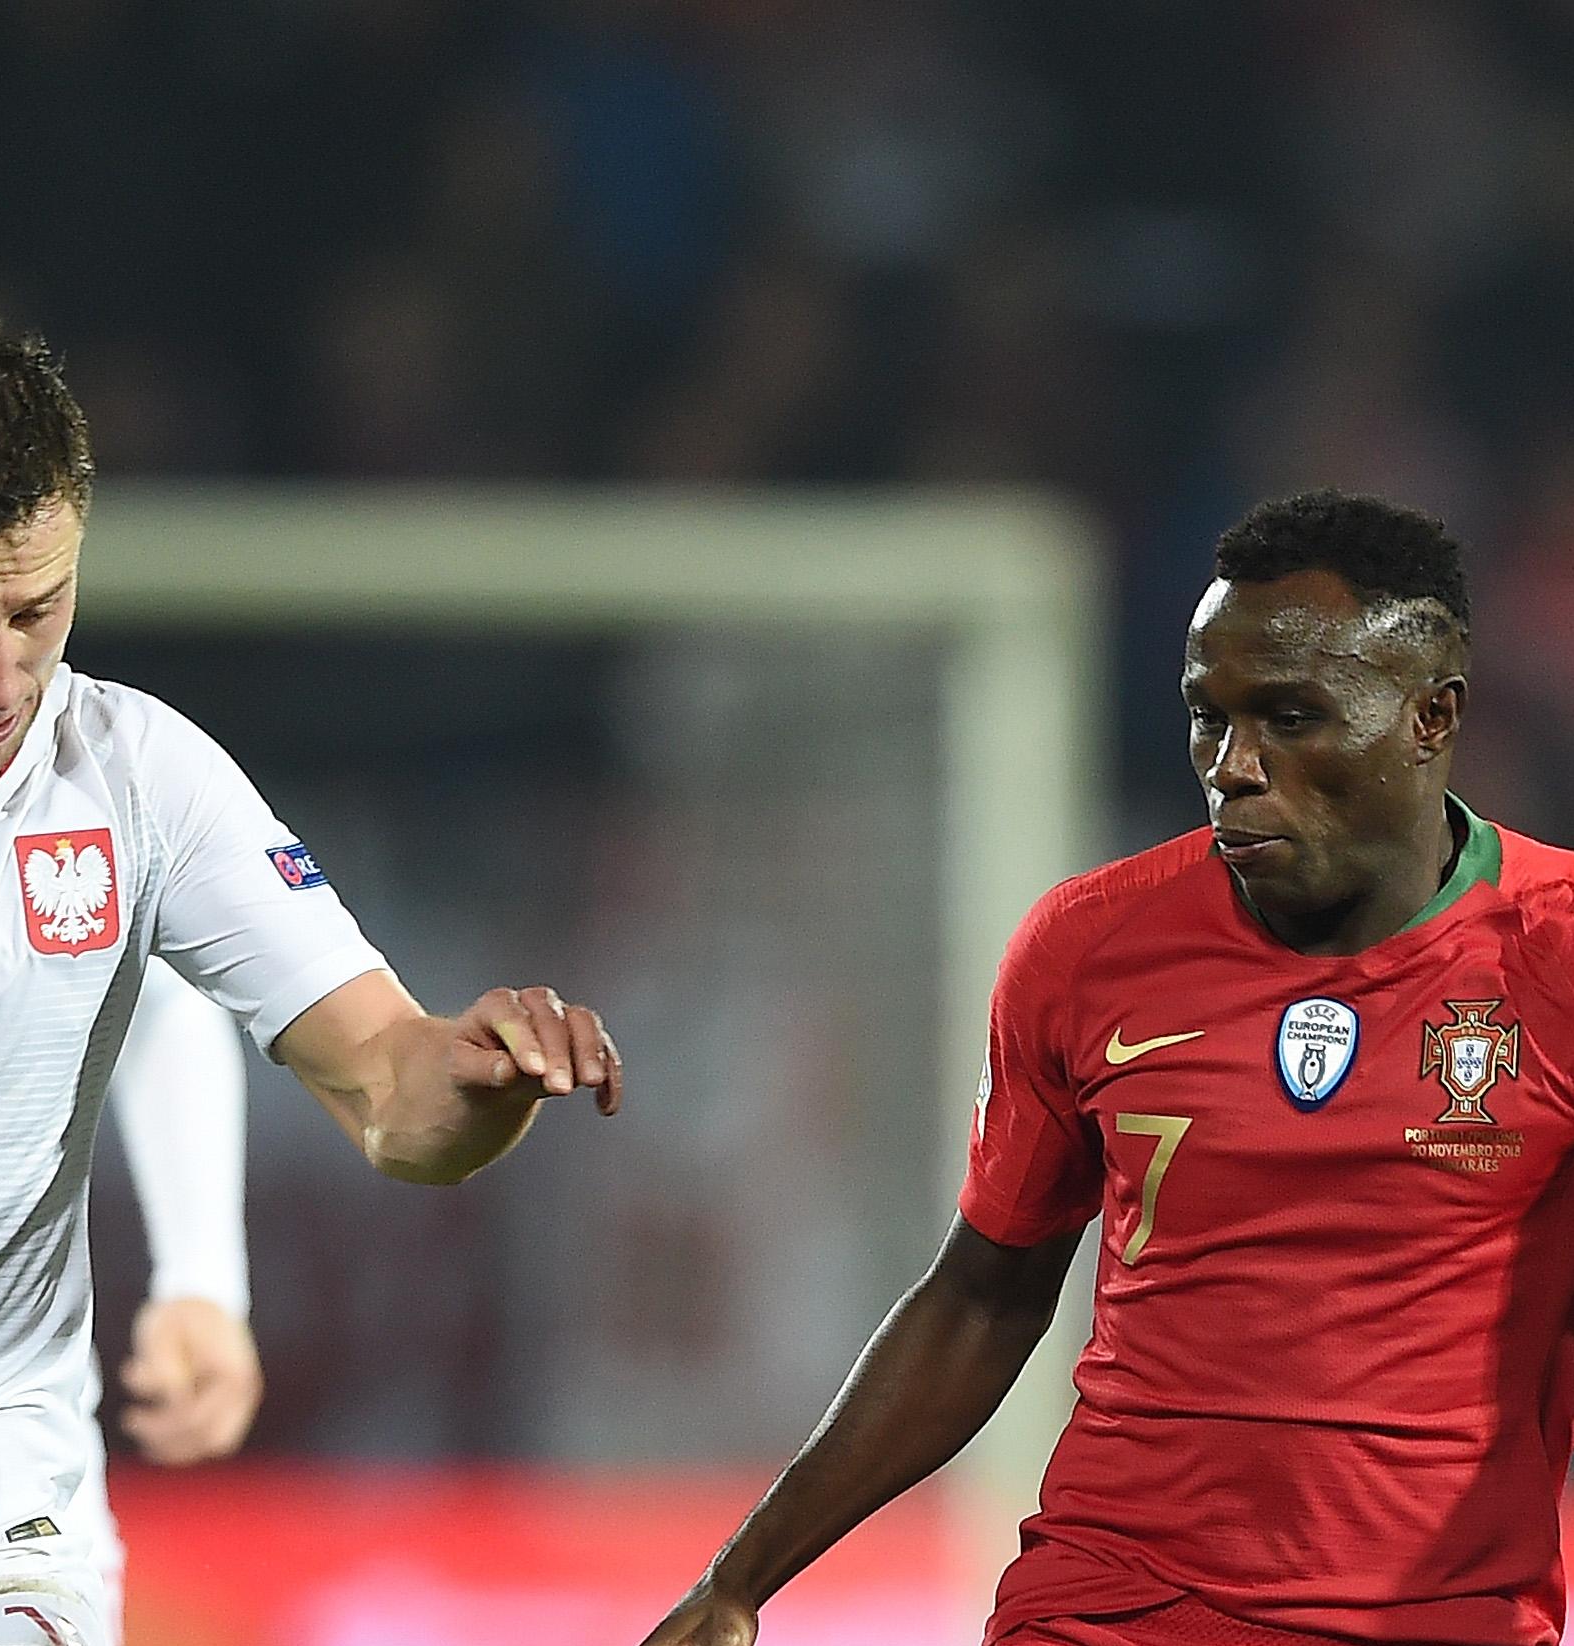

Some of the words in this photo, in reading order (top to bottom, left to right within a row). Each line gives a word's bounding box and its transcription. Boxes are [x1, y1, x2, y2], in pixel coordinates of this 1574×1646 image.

[1305, 1005, 1337, 1020] UEFA
[1288, 1021, 1350, 1035] EUROPEAN
[1287, 1031, 1348, 1046] CHAMPIONS
[1411, 1144, 1426, 1157] 20
[1428, 1143, 1492, 1157] NOVEMBRO
[1495, 1144, 1522, 1157] 2018
[1116, 1113, 1193, 1265] 7
